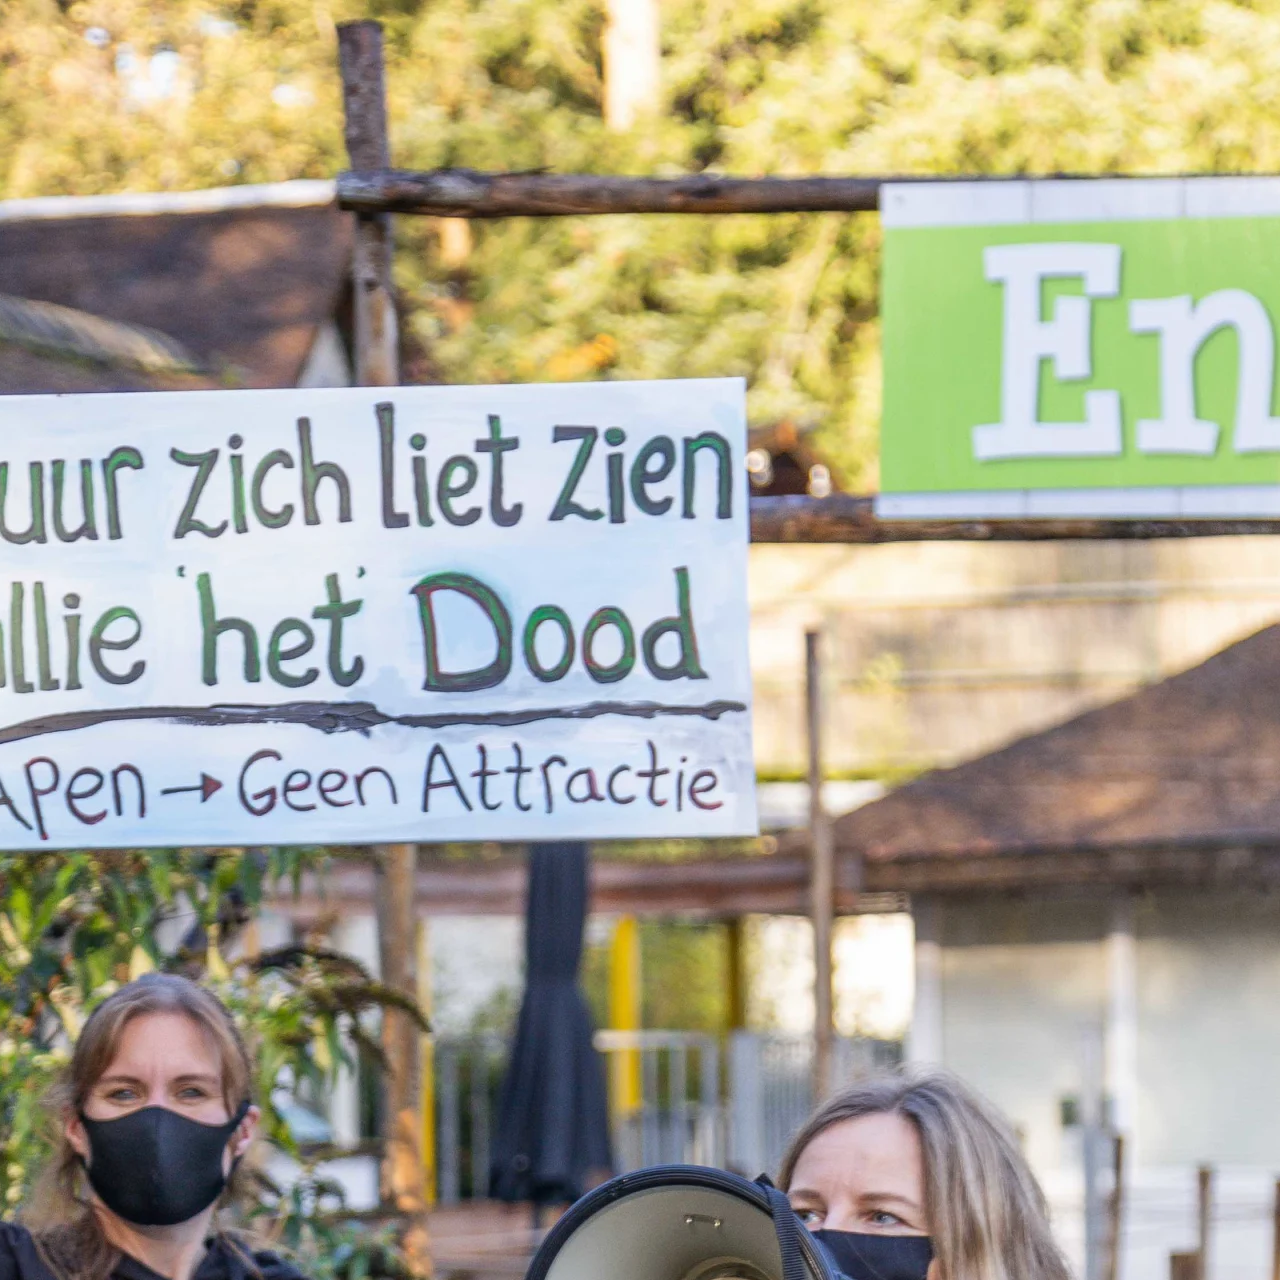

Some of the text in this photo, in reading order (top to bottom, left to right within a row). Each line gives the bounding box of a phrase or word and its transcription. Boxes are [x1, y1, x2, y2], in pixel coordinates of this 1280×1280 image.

[170, 415, 353, 540] zich
[375, 401, 524, 530] liet
[410, 565, 709, 693] Dood
[238, 749, 399, 817] Geen
[421, 740, 725, 815] Attractie
